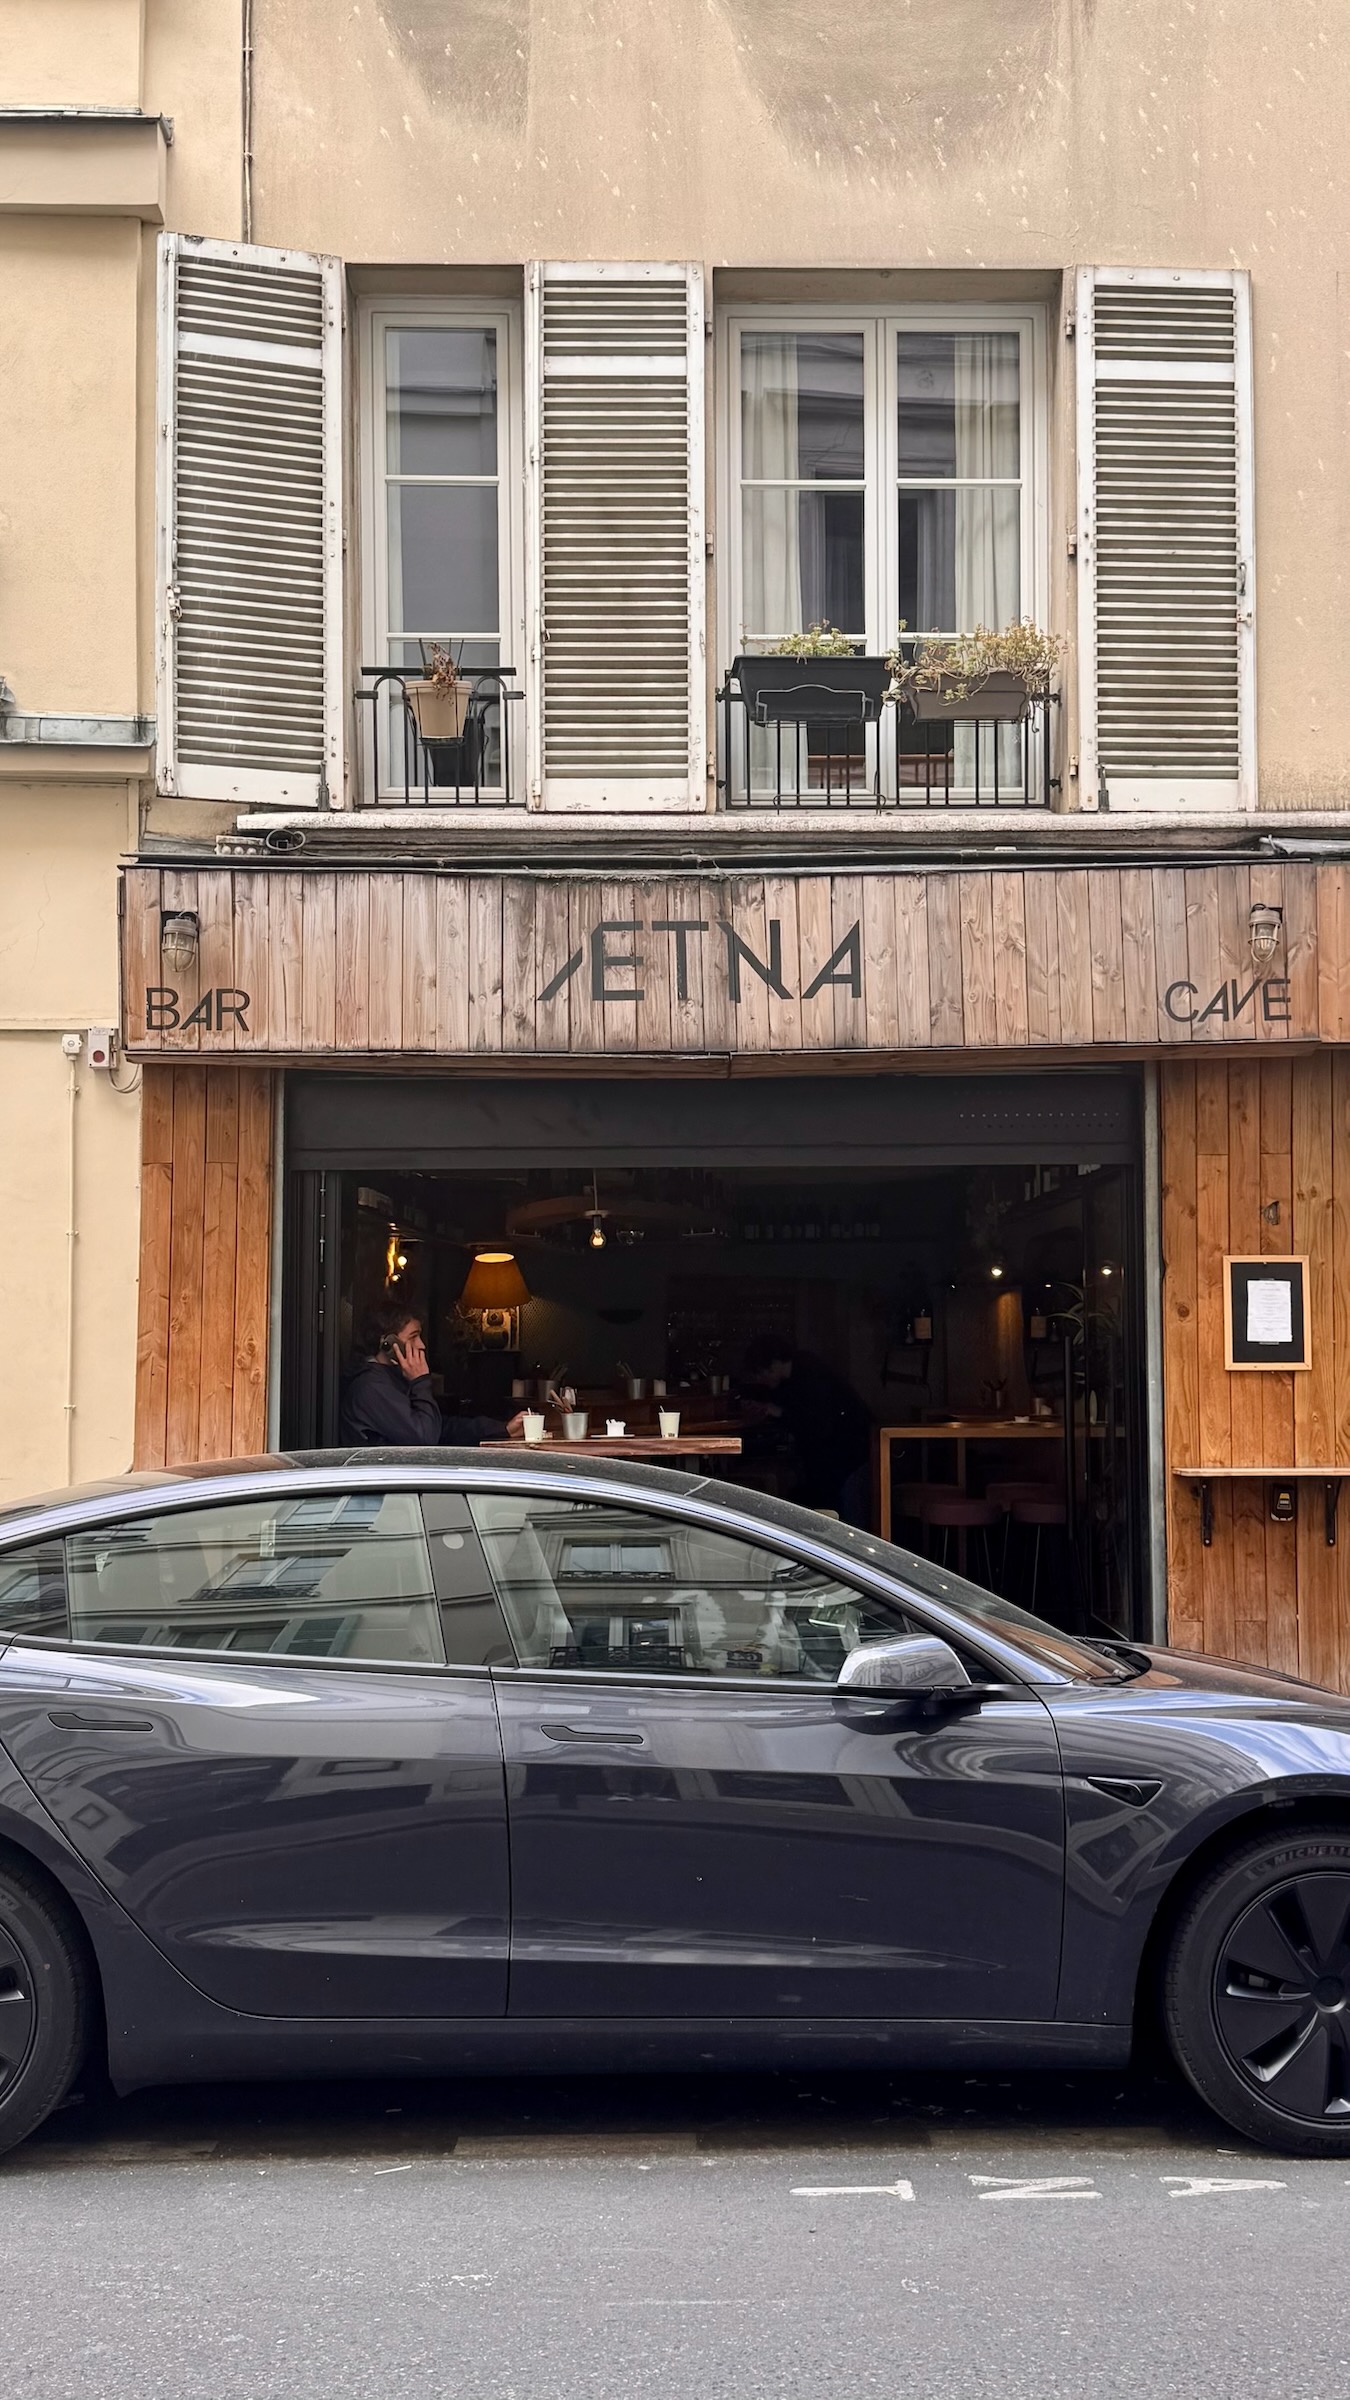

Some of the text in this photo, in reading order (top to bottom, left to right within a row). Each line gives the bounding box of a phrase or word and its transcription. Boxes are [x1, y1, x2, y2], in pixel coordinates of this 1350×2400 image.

[146, 987, 251, 1032] BAR
[1164, 978, 1292, 1023] CAVE
[1274, 1845, 1350, 1865] MICHELI
